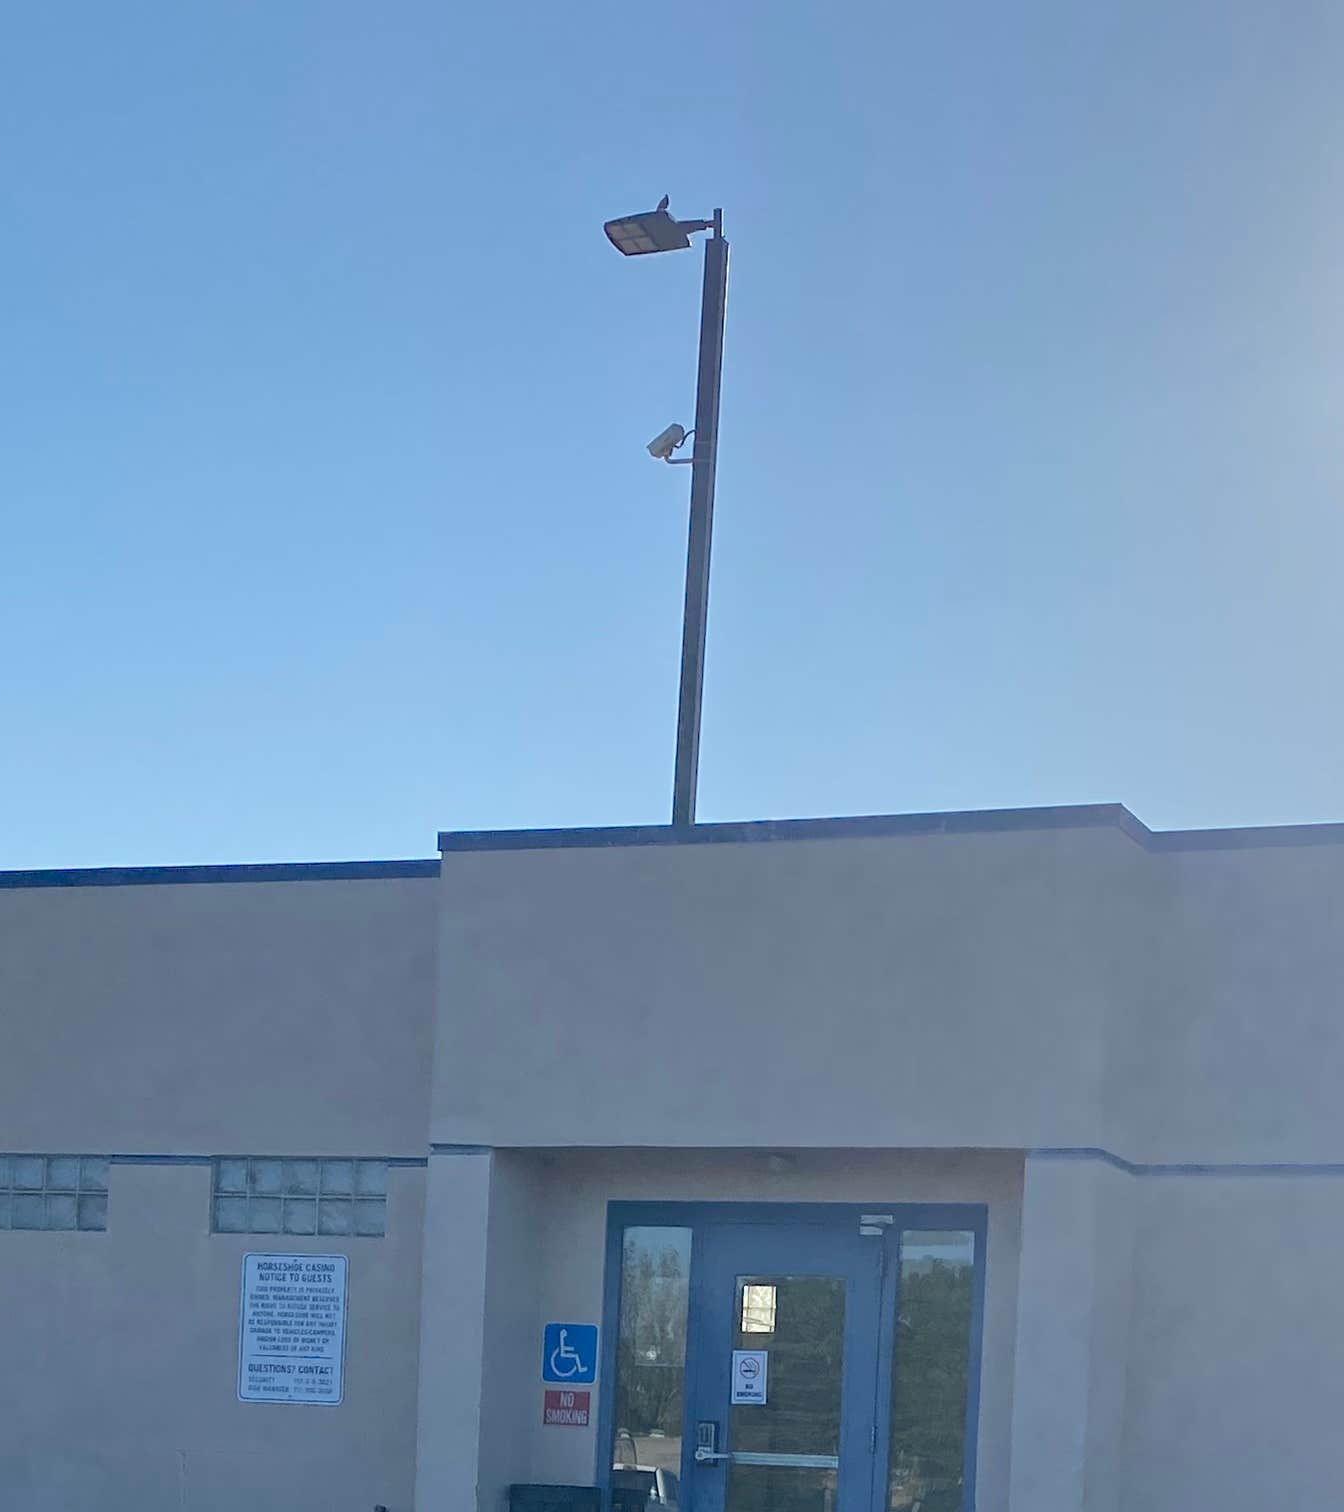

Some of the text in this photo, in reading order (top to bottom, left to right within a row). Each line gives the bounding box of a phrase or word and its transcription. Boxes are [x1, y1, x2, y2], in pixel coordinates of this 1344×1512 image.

[257, 1262, 335, 1272] HORSESHOE CASINO
[258, 1272, 333, 1283] NOTICE TO GUESTS
[298, 1365, 334, 1375] CONTACT
[560, 1391, 575, 1408] NO
[546, 1408, 588, 1425] SMOKING
